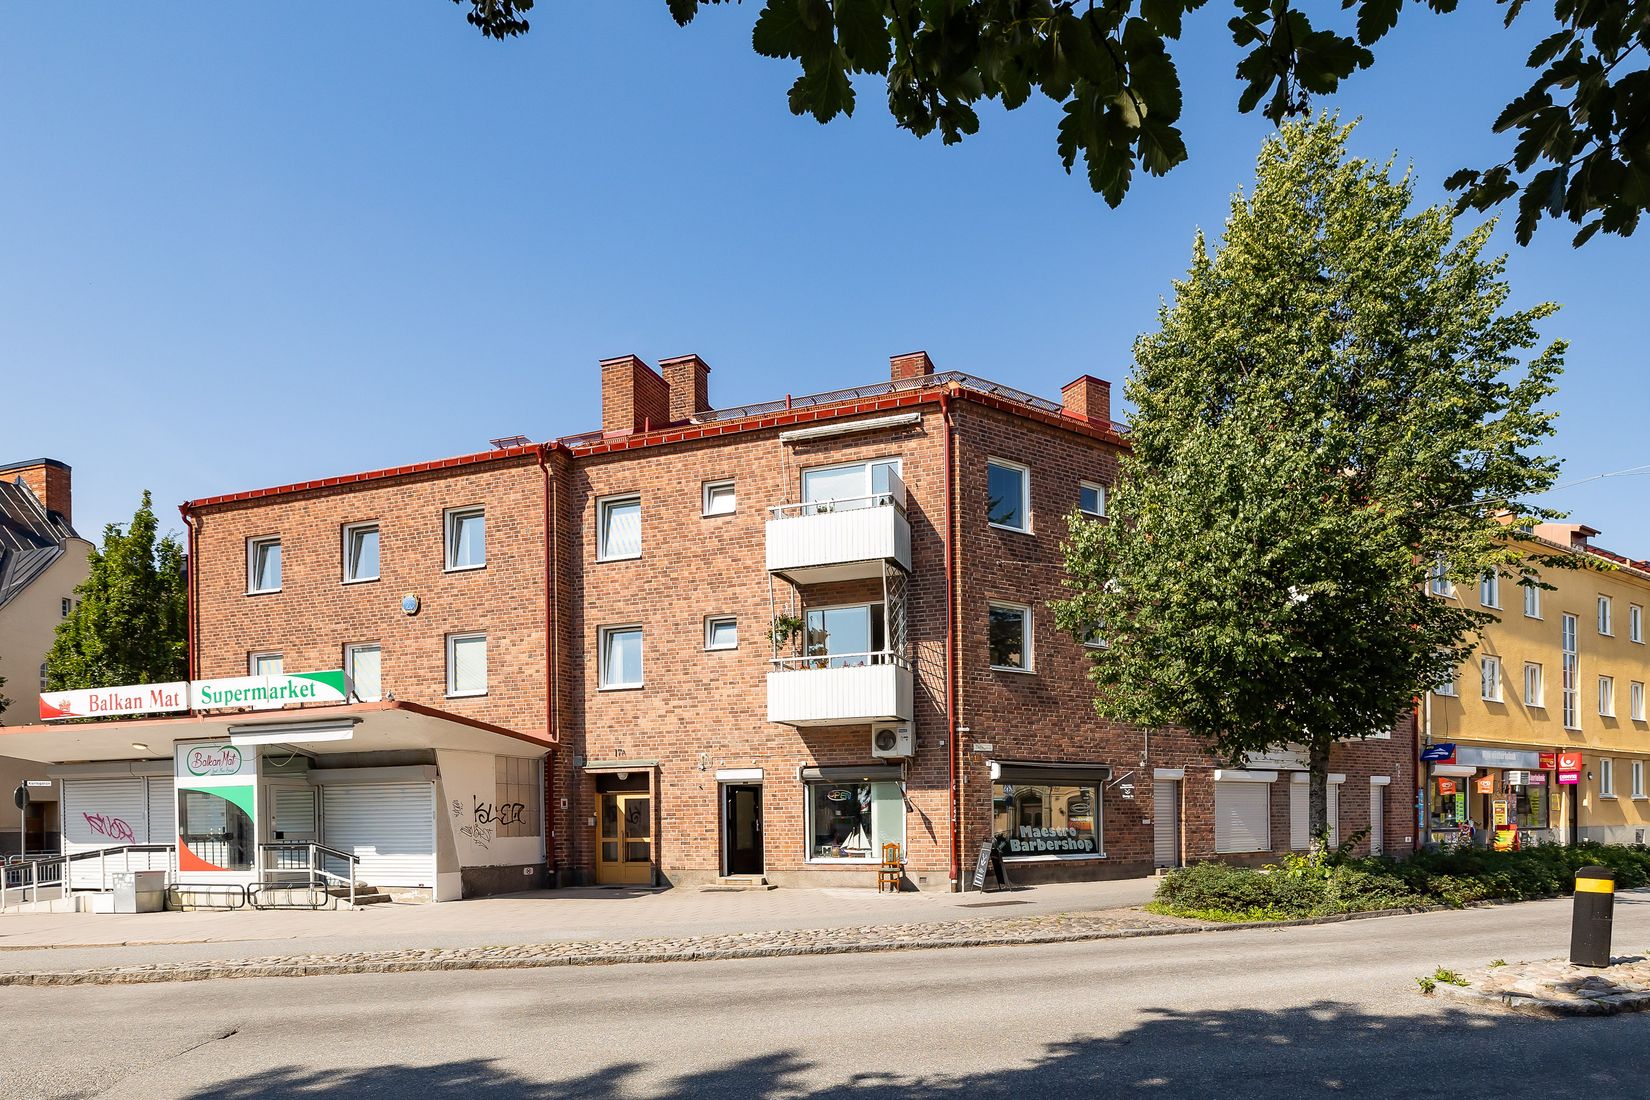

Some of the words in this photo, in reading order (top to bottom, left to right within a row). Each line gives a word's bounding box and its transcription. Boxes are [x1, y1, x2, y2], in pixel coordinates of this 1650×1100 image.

[89, 693, 143, 712] Balkan
[150, 689, 180, 708] Mat
[201, 680, 316, 706] Supermarket
[191, 752, 222, 768] Balkan
[222, 750, 237, 766] Mat
[1019, 825, 1077, 838] Maestro
[1010, 838, 1093, 852] Barbershop
